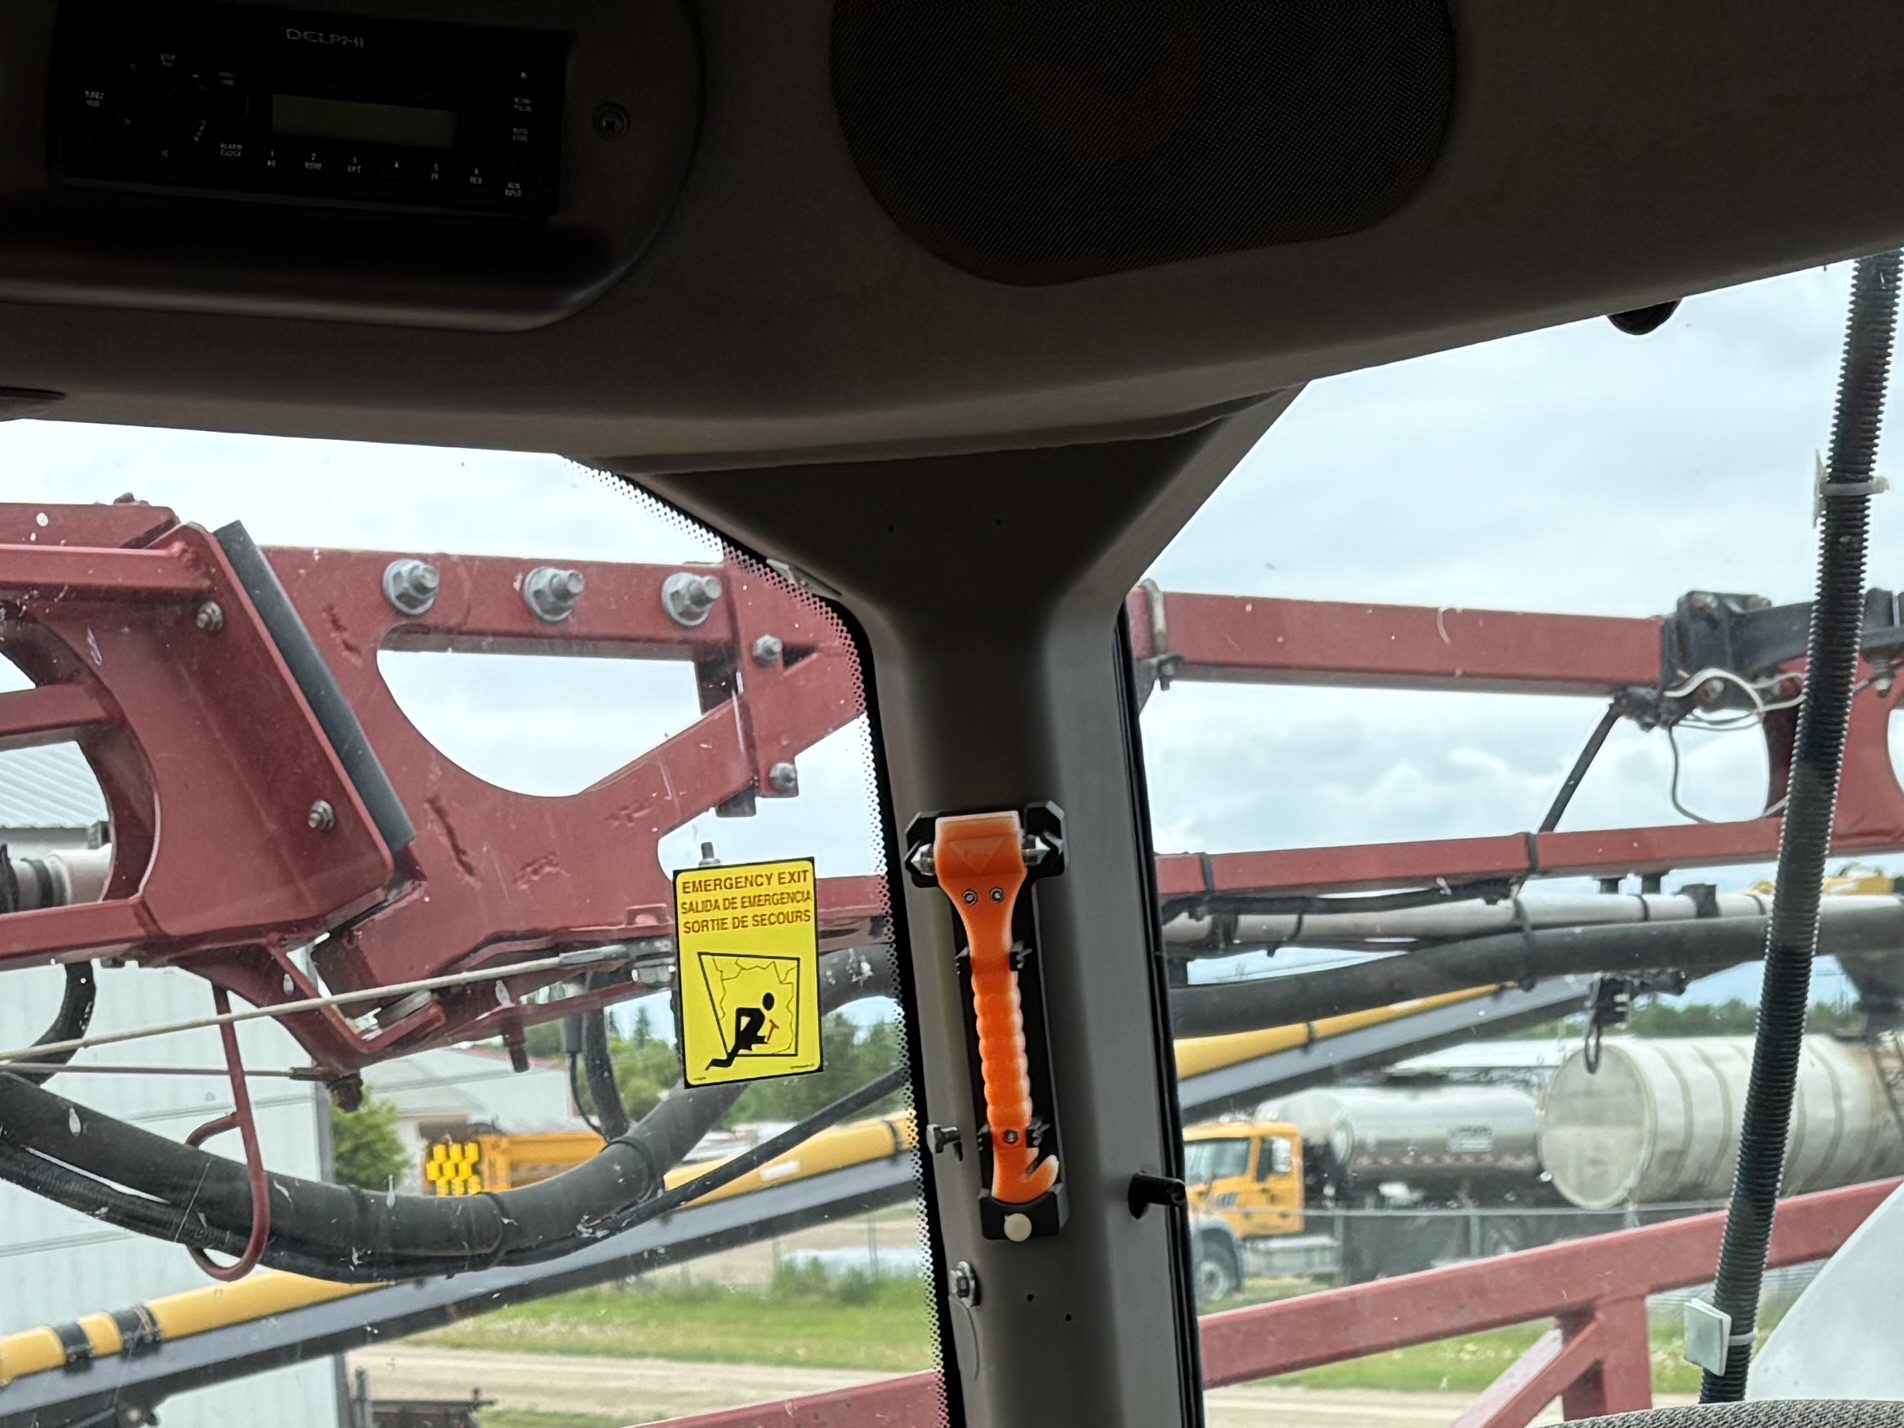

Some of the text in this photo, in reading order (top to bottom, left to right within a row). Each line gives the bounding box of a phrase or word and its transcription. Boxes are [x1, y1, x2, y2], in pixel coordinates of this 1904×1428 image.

[285, 27, 365, 49] DELPHI
[682, 869, 809, 895] EMERGENCY EXIT
[680, 890, 812, 914] SALIDA DE EMERGENCIA
[683, 909, 811, 934] SORTIE DE SECOURS
